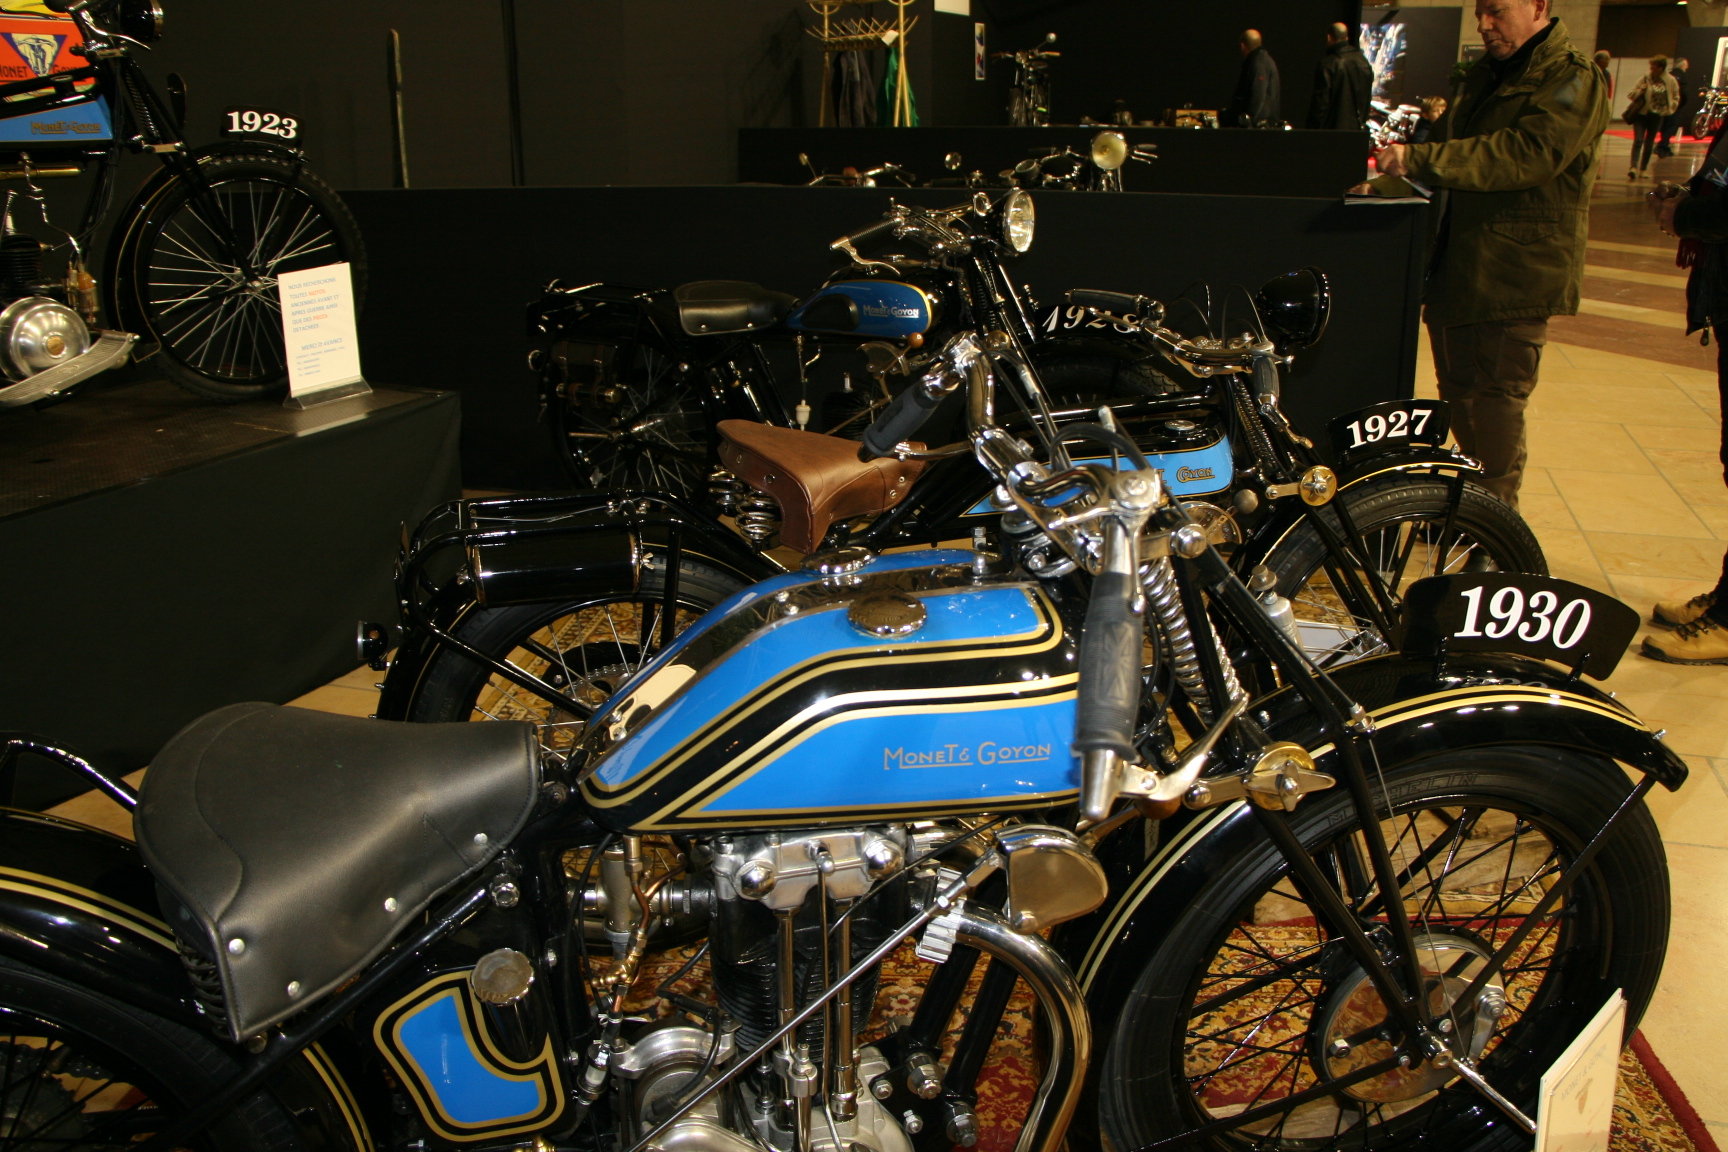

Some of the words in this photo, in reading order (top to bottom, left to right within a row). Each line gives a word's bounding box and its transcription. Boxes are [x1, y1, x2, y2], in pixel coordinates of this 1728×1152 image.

[227, 111, 297, 139] 1923
[308, 288, 326, 296] MOTOS
[891, 306, 920, 319] GOYON
[1346, 408, 1433, 449] 1927
[1453, 585, 1591, 650] 1930
[884, 744, 960, 770] MONET
[977, 741, 1051, 765] GOYON
